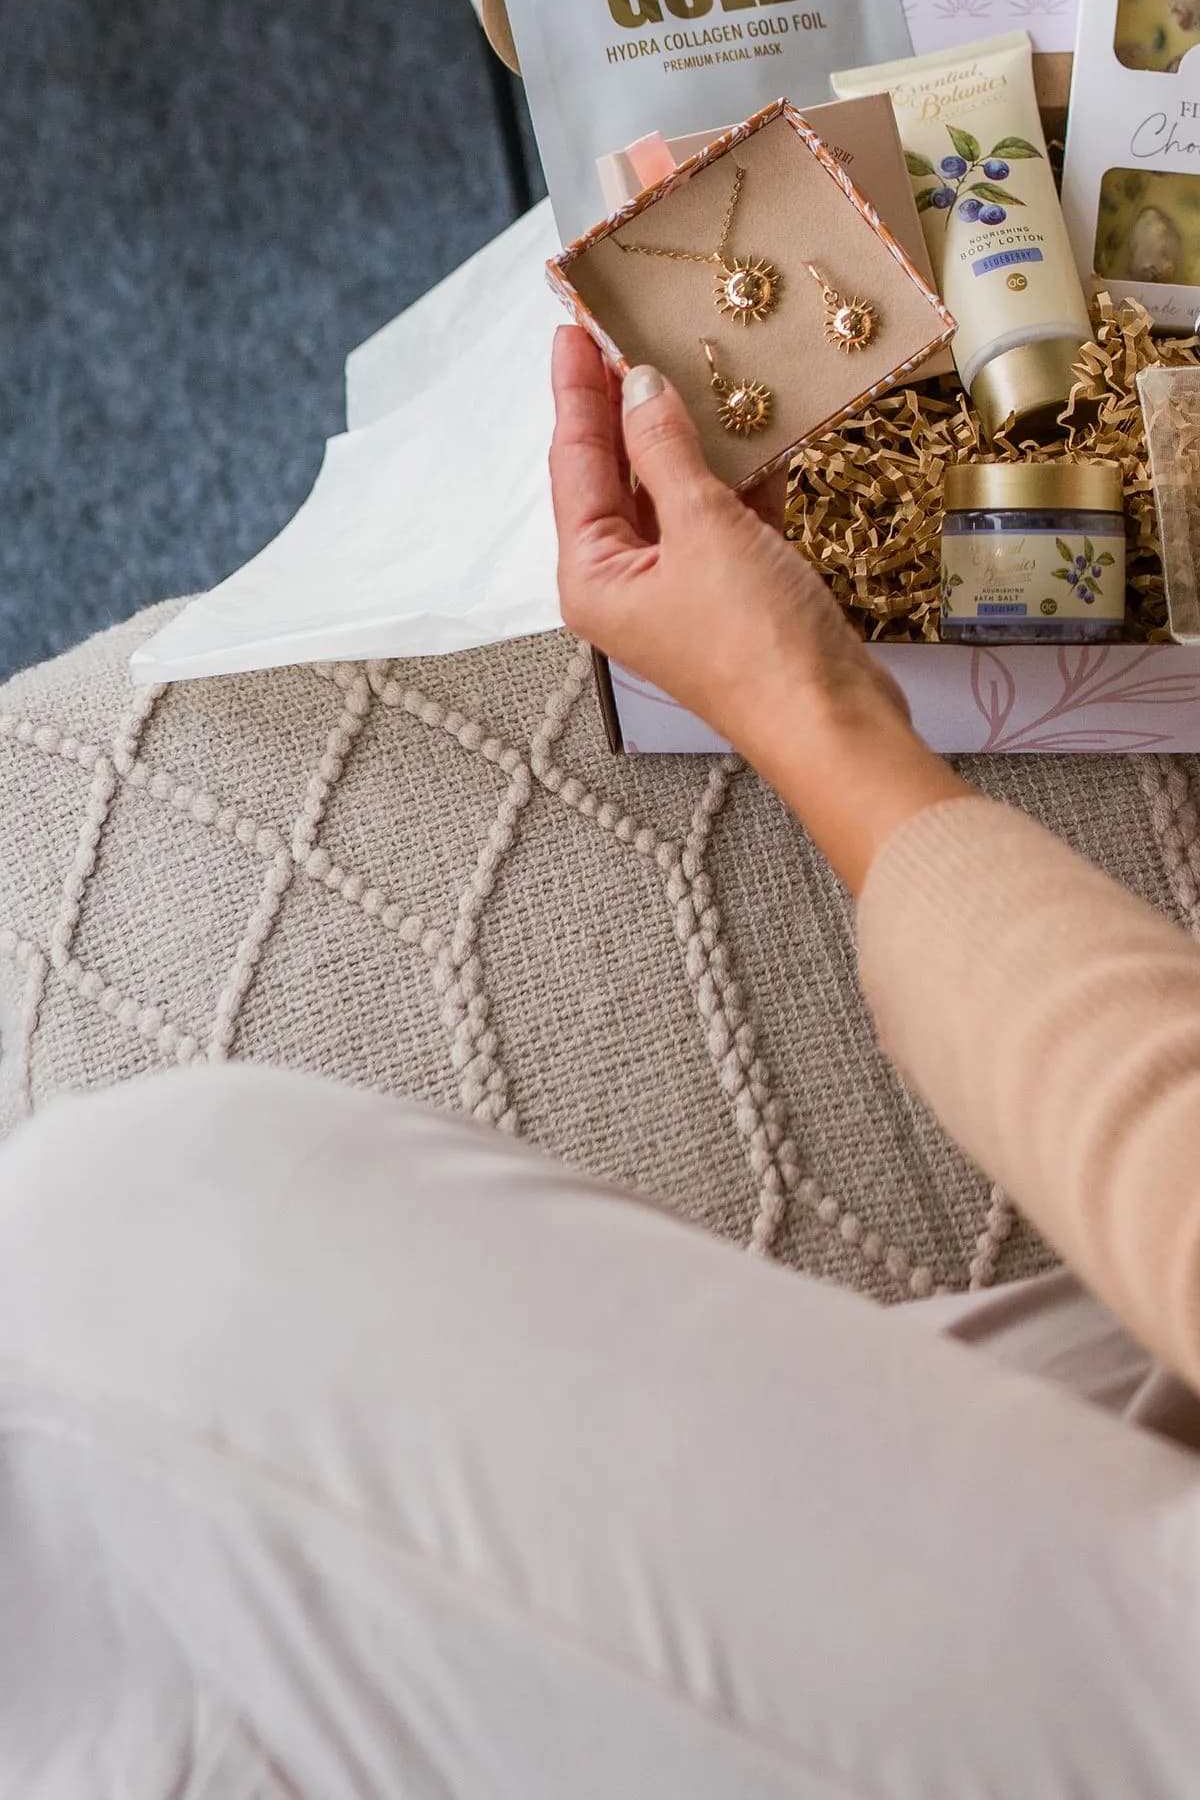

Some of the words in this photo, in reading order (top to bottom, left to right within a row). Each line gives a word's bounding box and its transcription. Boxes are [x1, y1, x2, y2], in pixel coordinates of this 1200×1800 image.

[606, 38, 661, 64] HYDRA
[664, 24, 743, 51] COLLAGEN
[747, 16, 790, 37] GOLD
[793, 12, 828, 31] FOIL
[663, 53, 714, 73] PREMIUM
[715, 47, 752, 65] FACIAL
[754, 42, 784, 58] MASK
[960, 242, 992, 261] BODY
[998, 234, 1044, 246] LOTION
[969, 226, 1030, 244] NOURISHING
[983, 251, 1032, 270] BLUEBERRY
